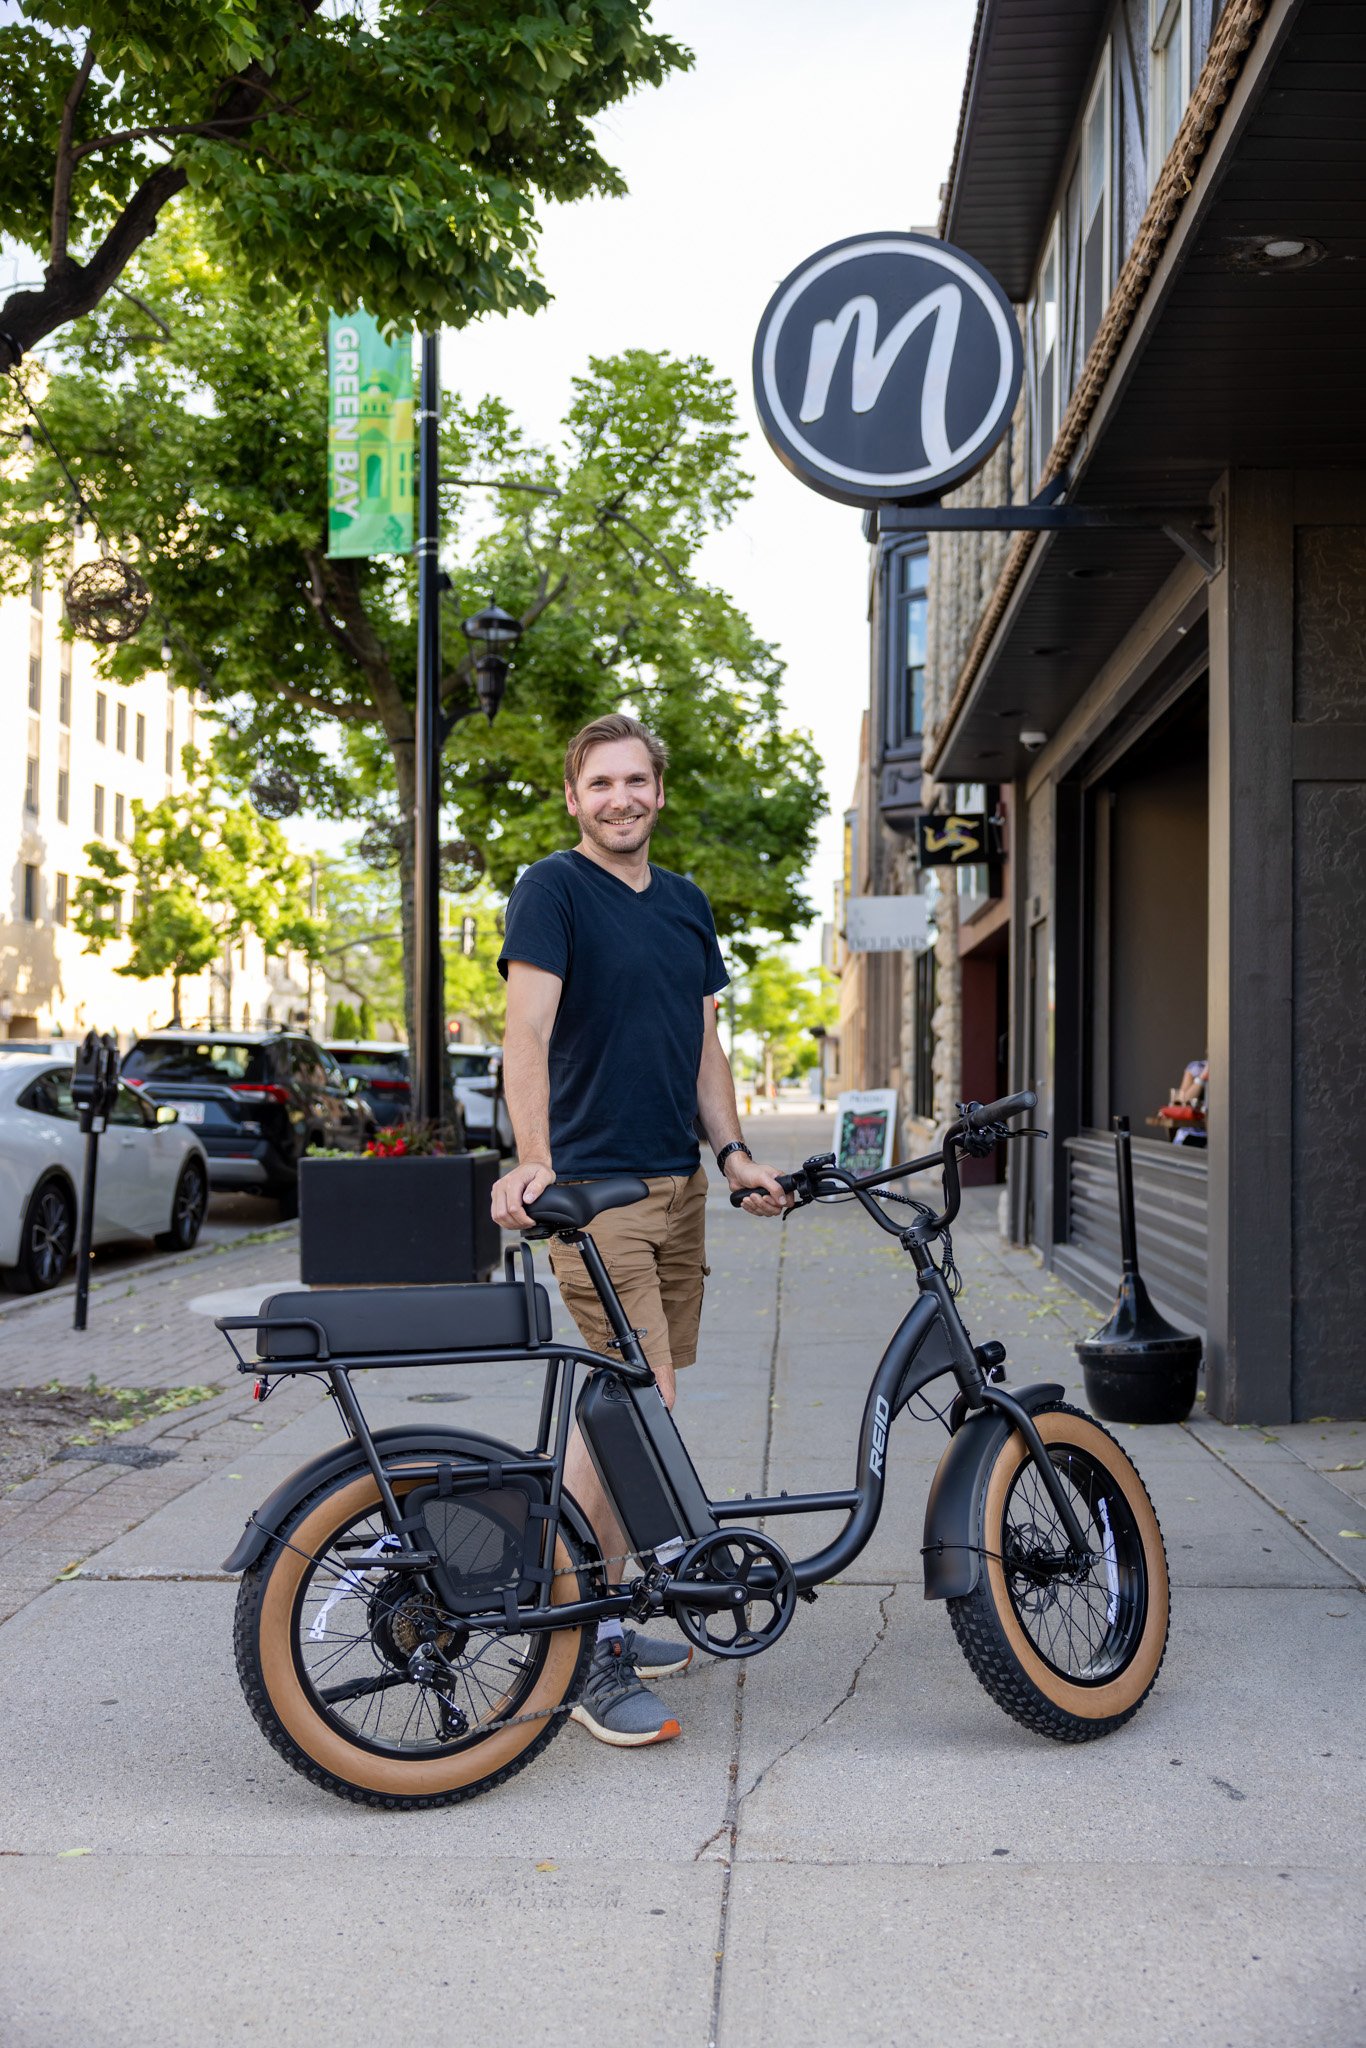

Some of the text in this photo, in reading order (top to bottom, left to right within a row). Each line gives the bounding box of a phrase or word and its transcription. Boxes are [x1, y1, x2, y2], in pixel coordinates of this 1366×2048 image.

[334, 326, 361, 521] GREEN BAY
[869, 1394, 890, 1480] REID
